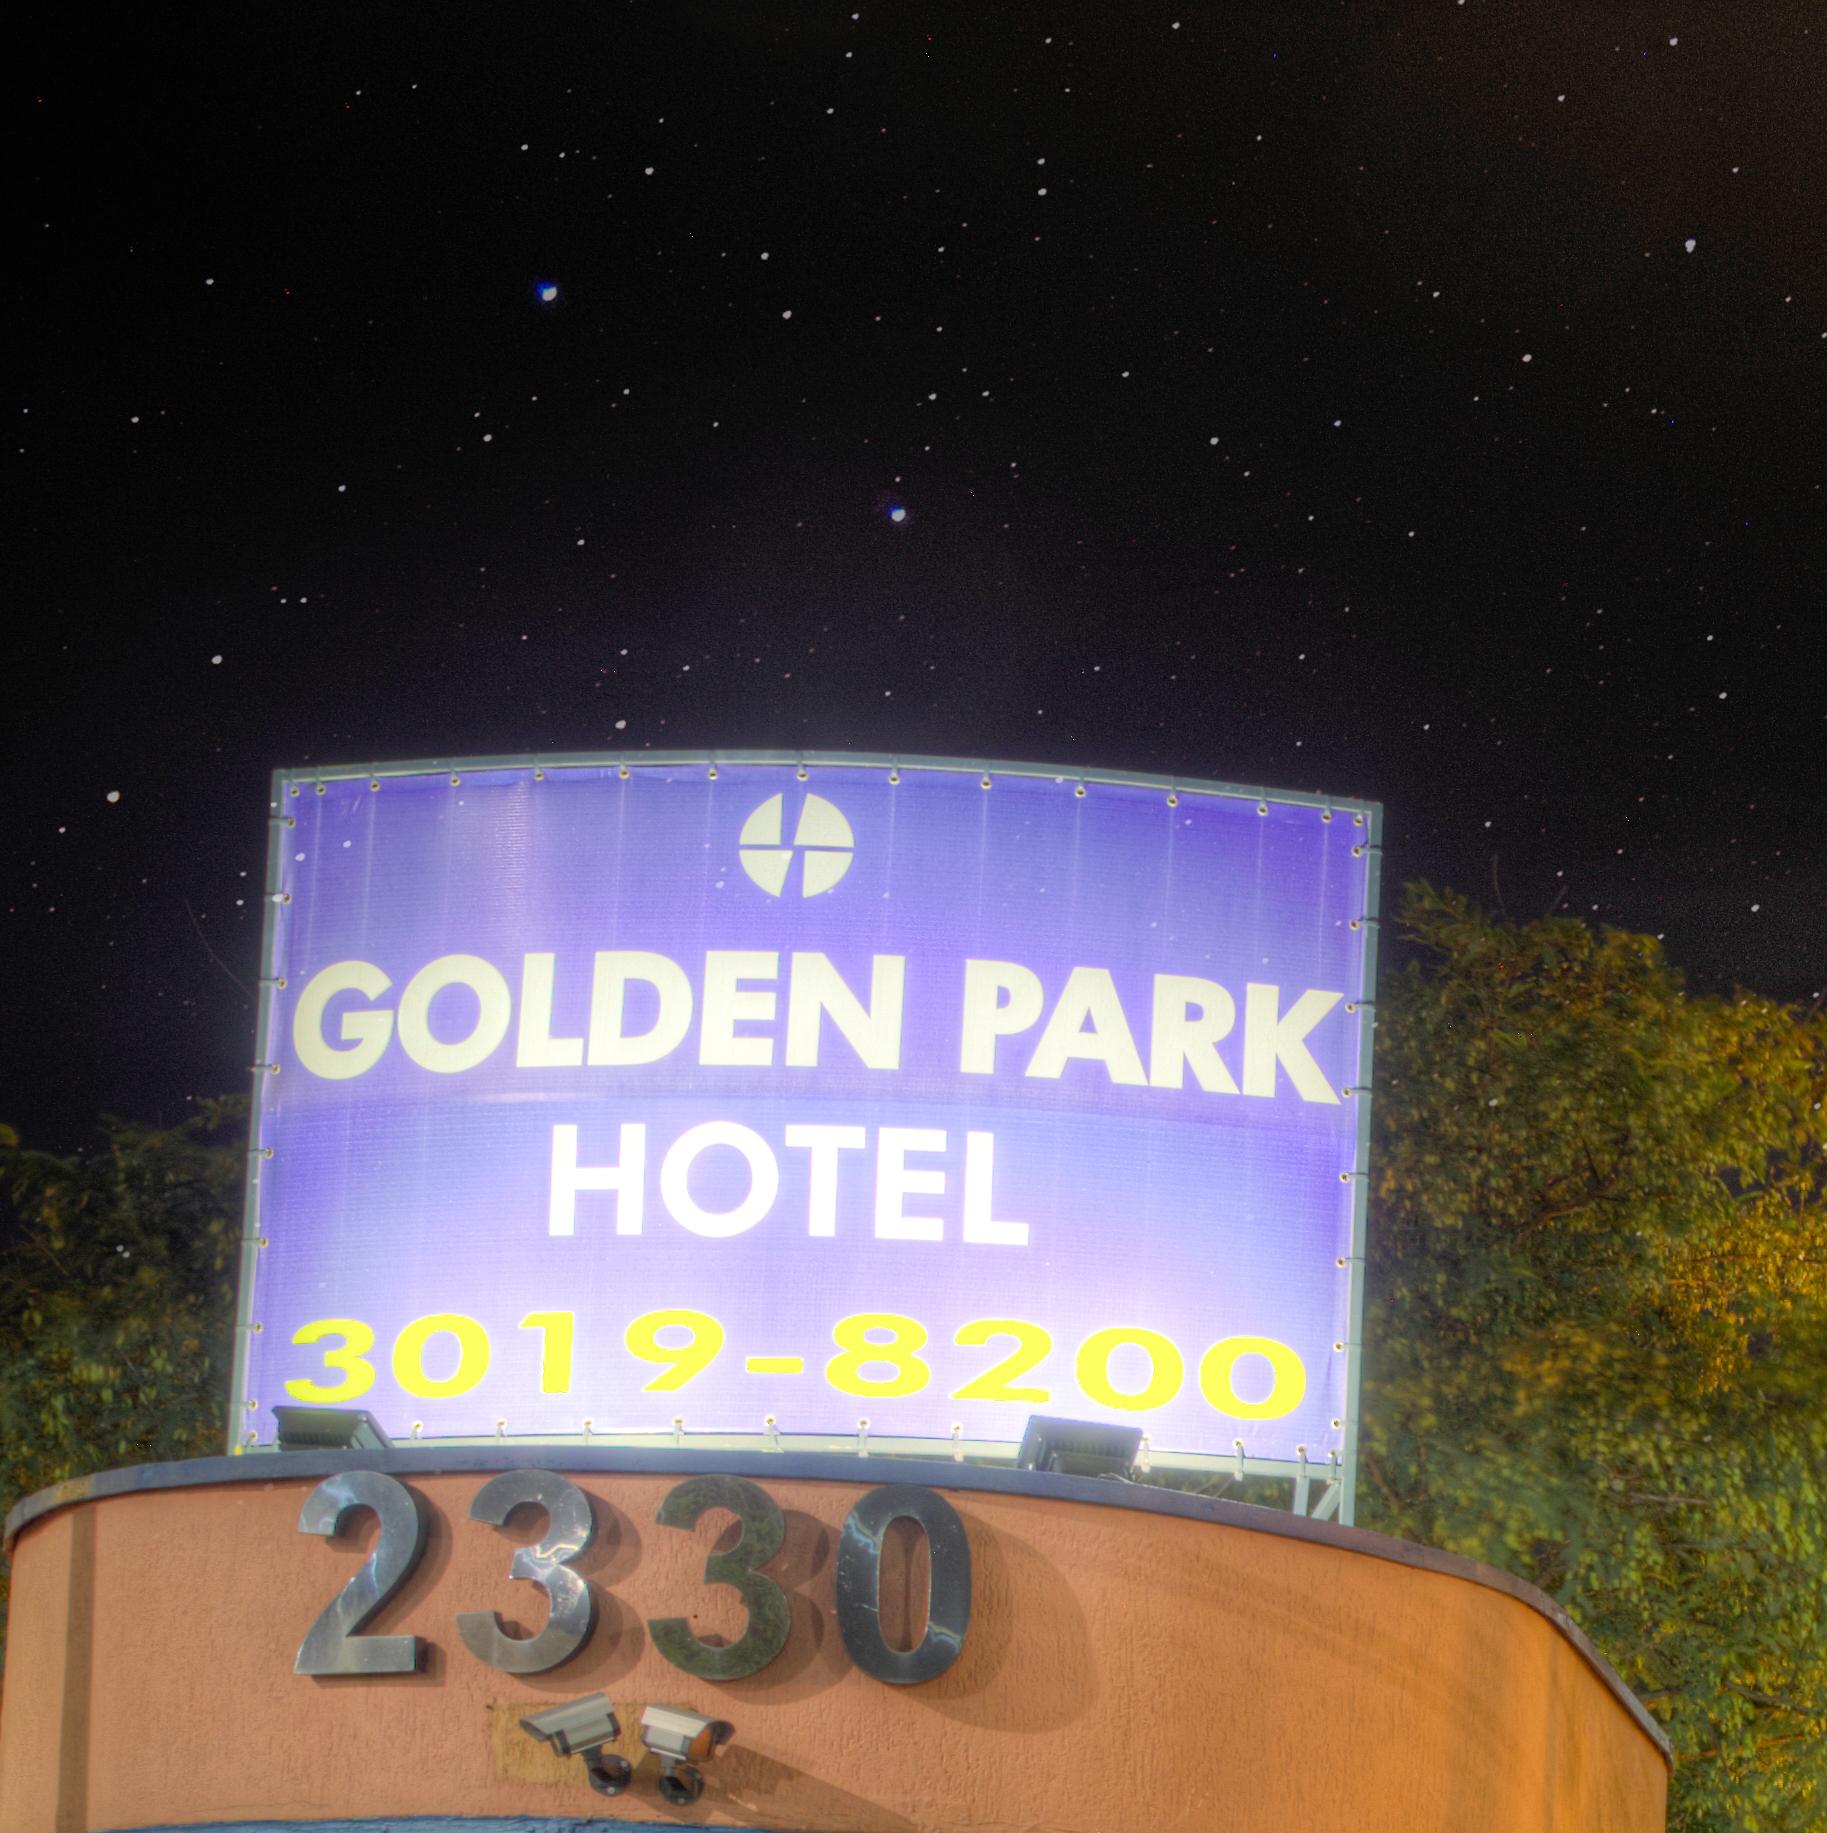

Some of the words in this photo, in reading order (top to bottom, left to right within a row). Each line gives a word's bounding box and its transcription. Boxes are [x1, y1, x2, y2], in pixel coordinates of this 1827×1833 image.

[292, 950, 906, 1080] GOLDEN
[960, 958, 1345, 1106] PARK
[548, 1120, 1030, 1246] HOTEL
[283, 1308, 1307, 1420] 3019-8200
[293, 1470, 972, 1684] 2330
